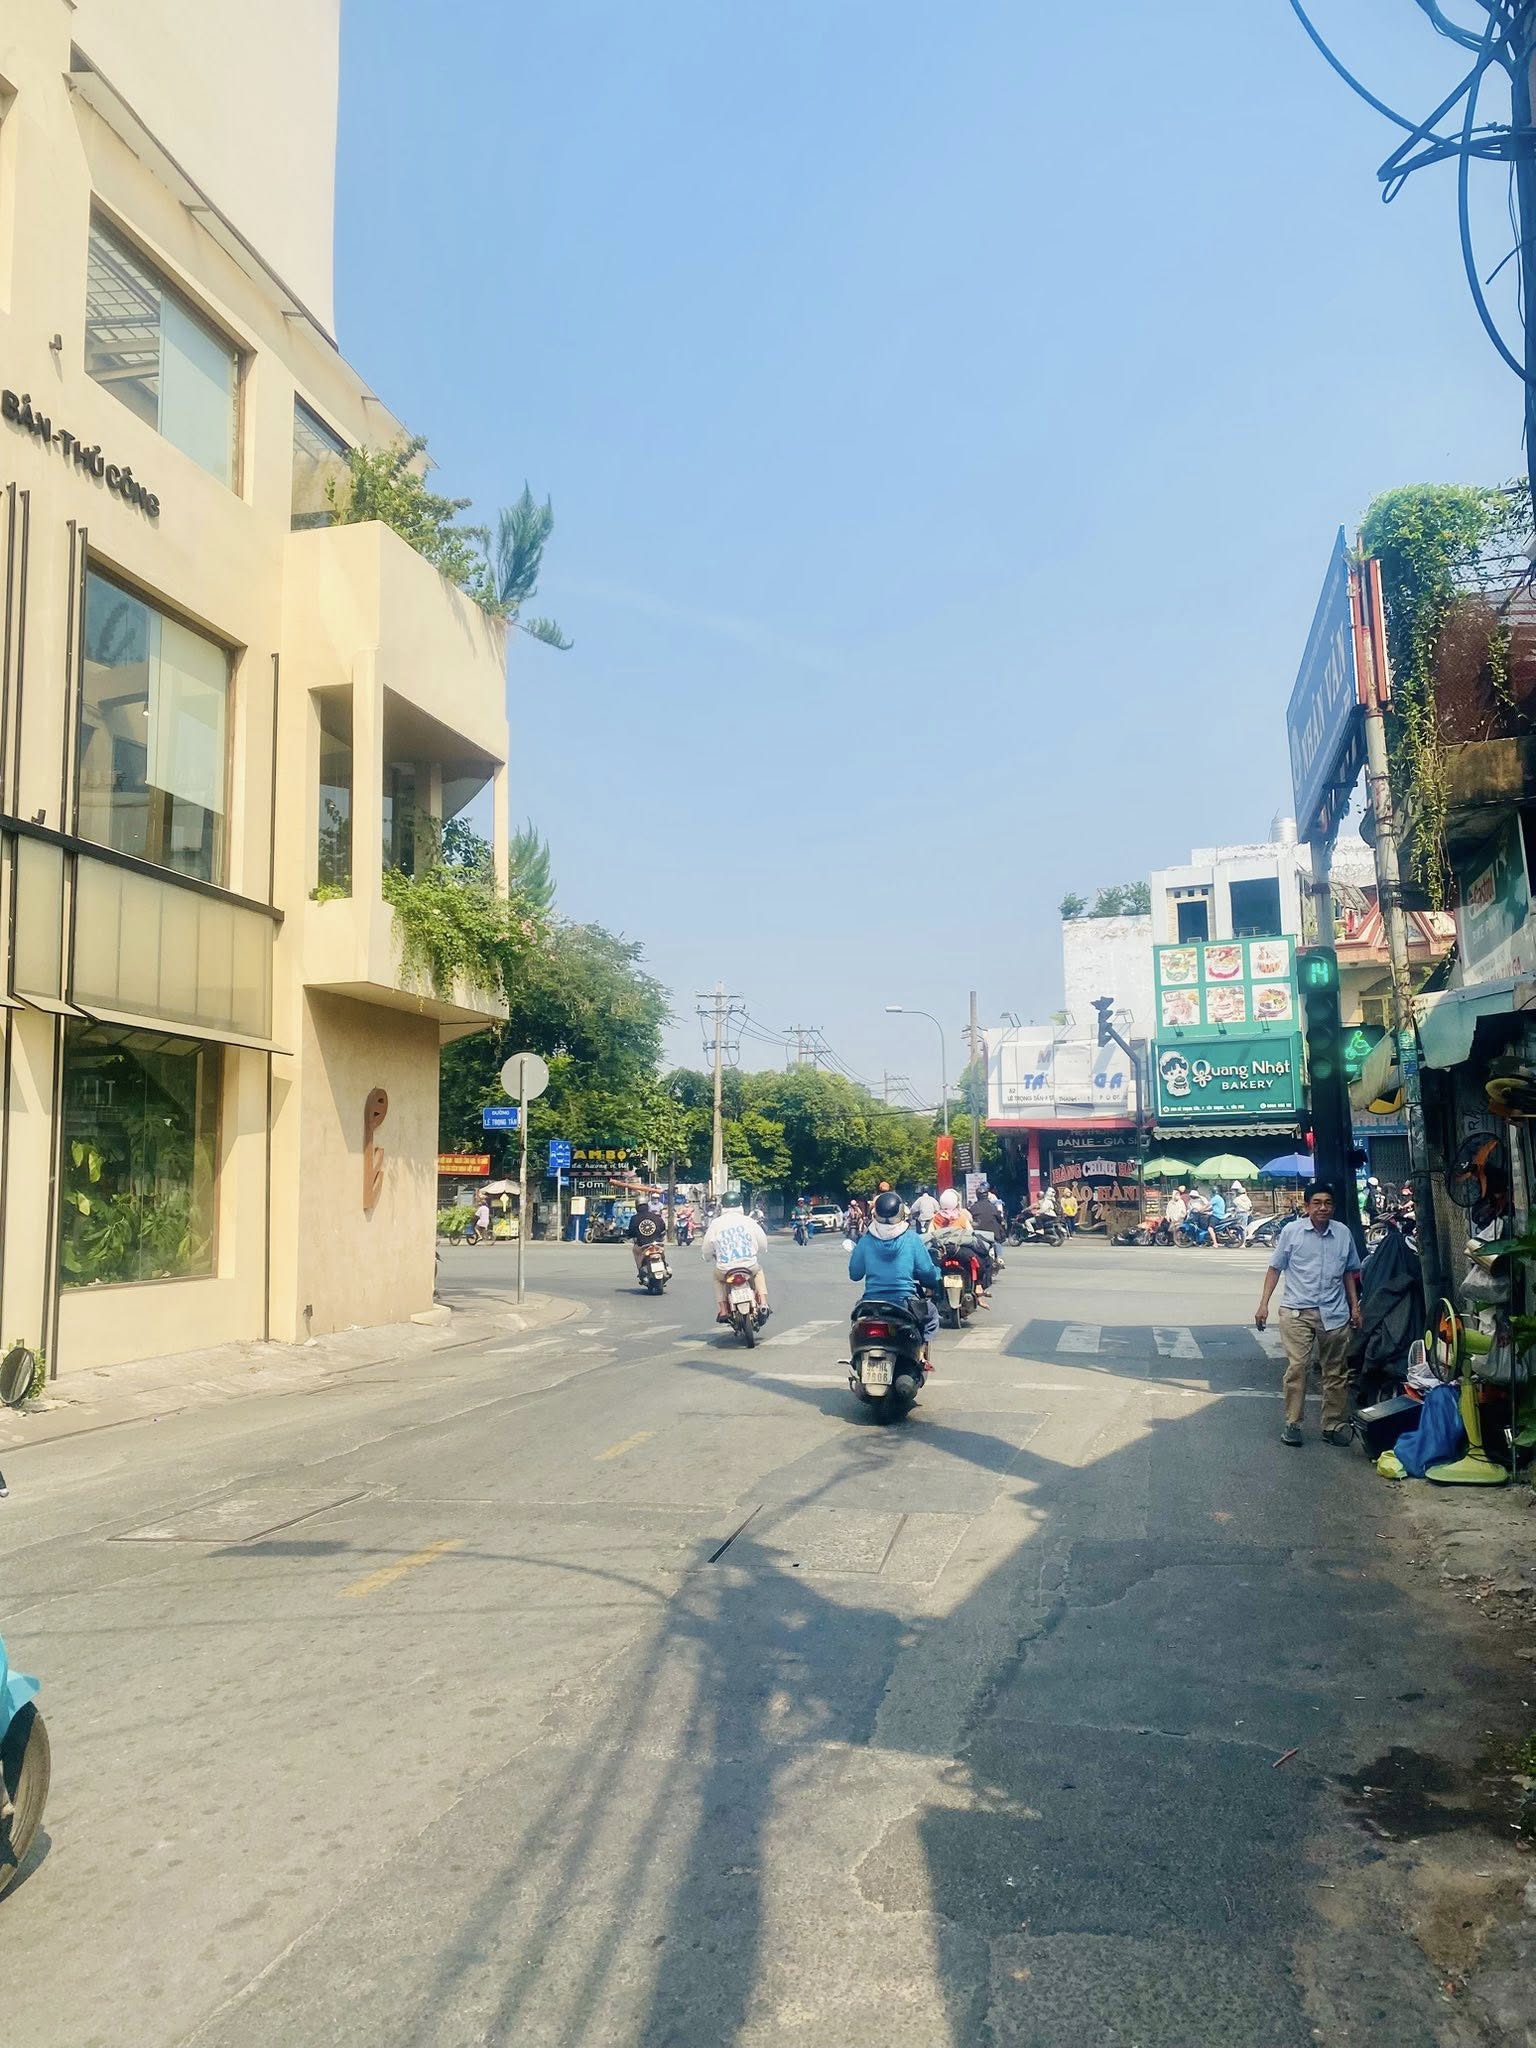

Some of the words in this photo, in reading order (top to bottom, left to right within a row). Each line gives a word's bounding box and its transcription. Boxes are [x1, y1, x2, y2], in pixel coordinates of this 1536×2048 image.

[105, 464, 160, 517] CÔNG
[1311, 962, 1329, 984] 14
[1192, 1060, 1249, 1087] Quang
[1252, 1060, 1290, 1076] Nhật
[1222, 1080, 1274, 1090] BAKERY
[1052, 1164, 1083, 1184] HÀNG
[1083, 1156, 1117, 1177] CHÍNH
[719, 1225, 745, 1238] TOO
